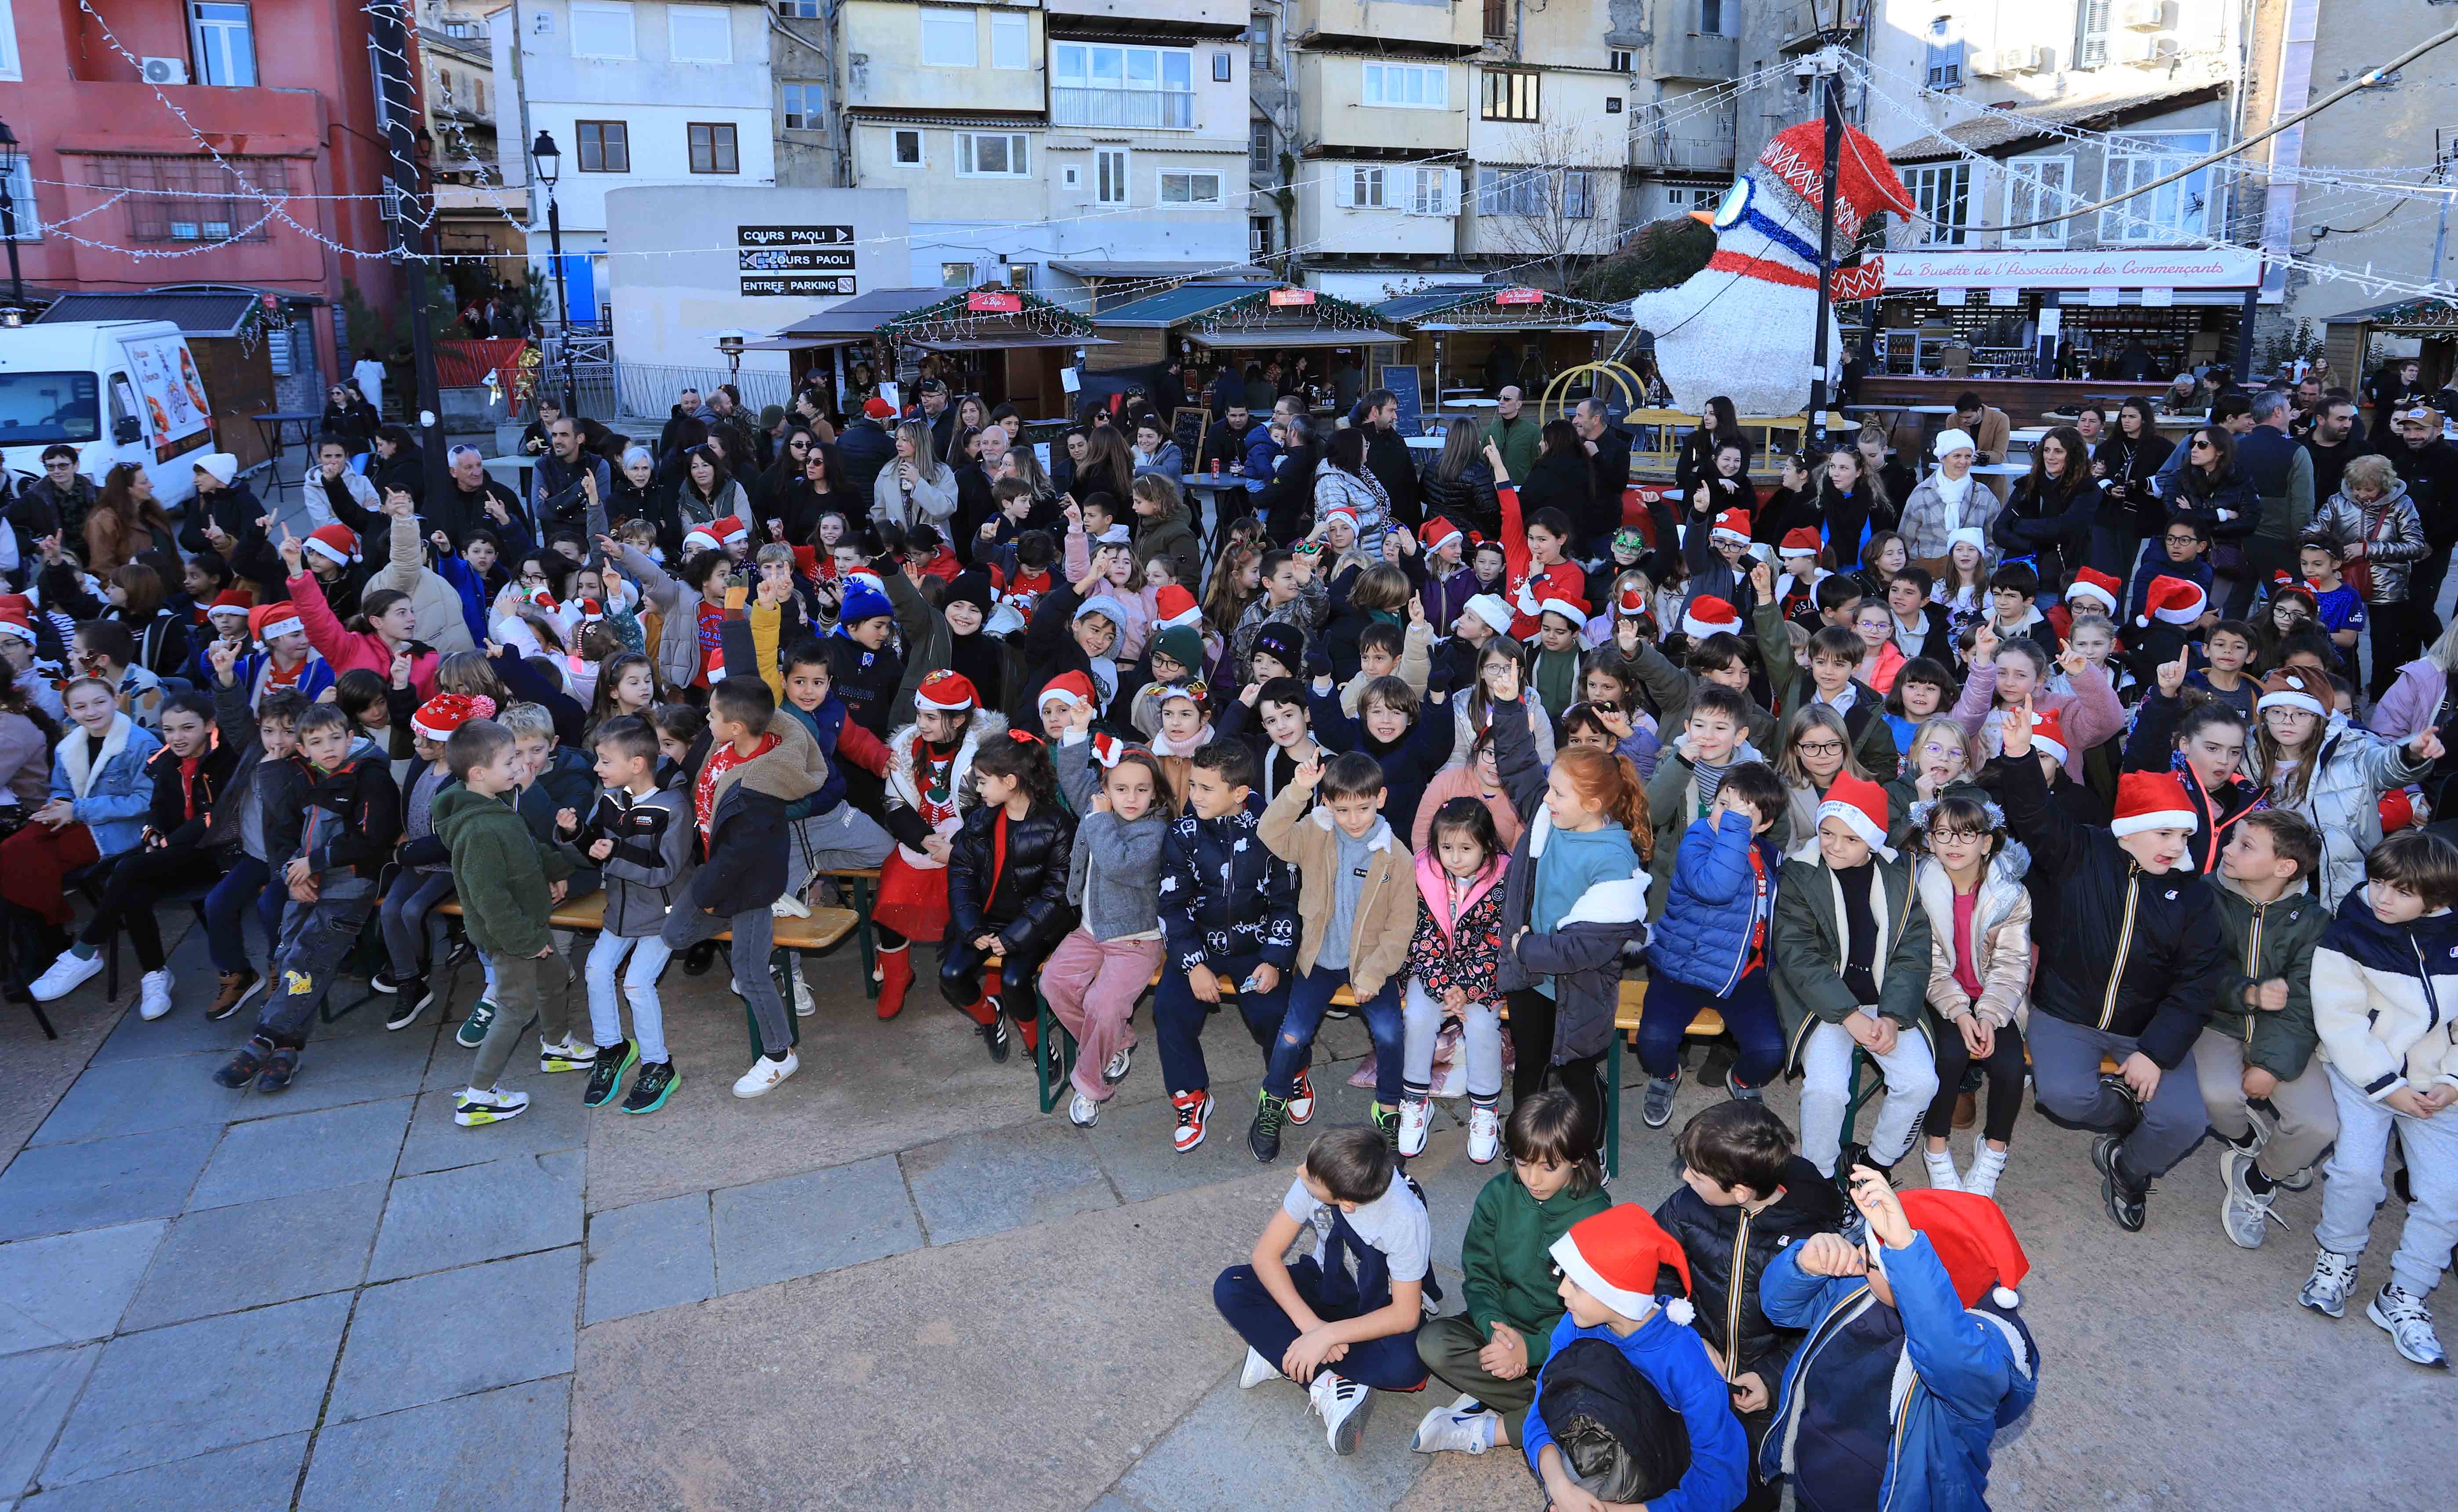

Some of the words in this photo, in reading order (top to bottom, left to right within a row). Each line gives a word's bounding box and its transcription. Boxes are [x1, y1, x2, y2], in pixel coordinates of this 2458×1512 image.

[743, 231, 785, 240] COURS
[791, 231, 825, 240] PAOLI
[769, 256, 810, 264] COURS
[816, 255, 850, 264] PAOLI
[1893, 263, 1913, 276] La
[1920, 263, 1970, 276] Buvette
[1974, 263, 1992, 276] de
[1995, 262, 2090, 276] l'Association
[2093, 262, 2116, 275] des
[2122, 260, 2224, 277] Commerçants
[743, 281, 785, 291] ENTREE
[791, 281, 836, 290] PARKING
[1475, 955, 1495, 964] KENZO
